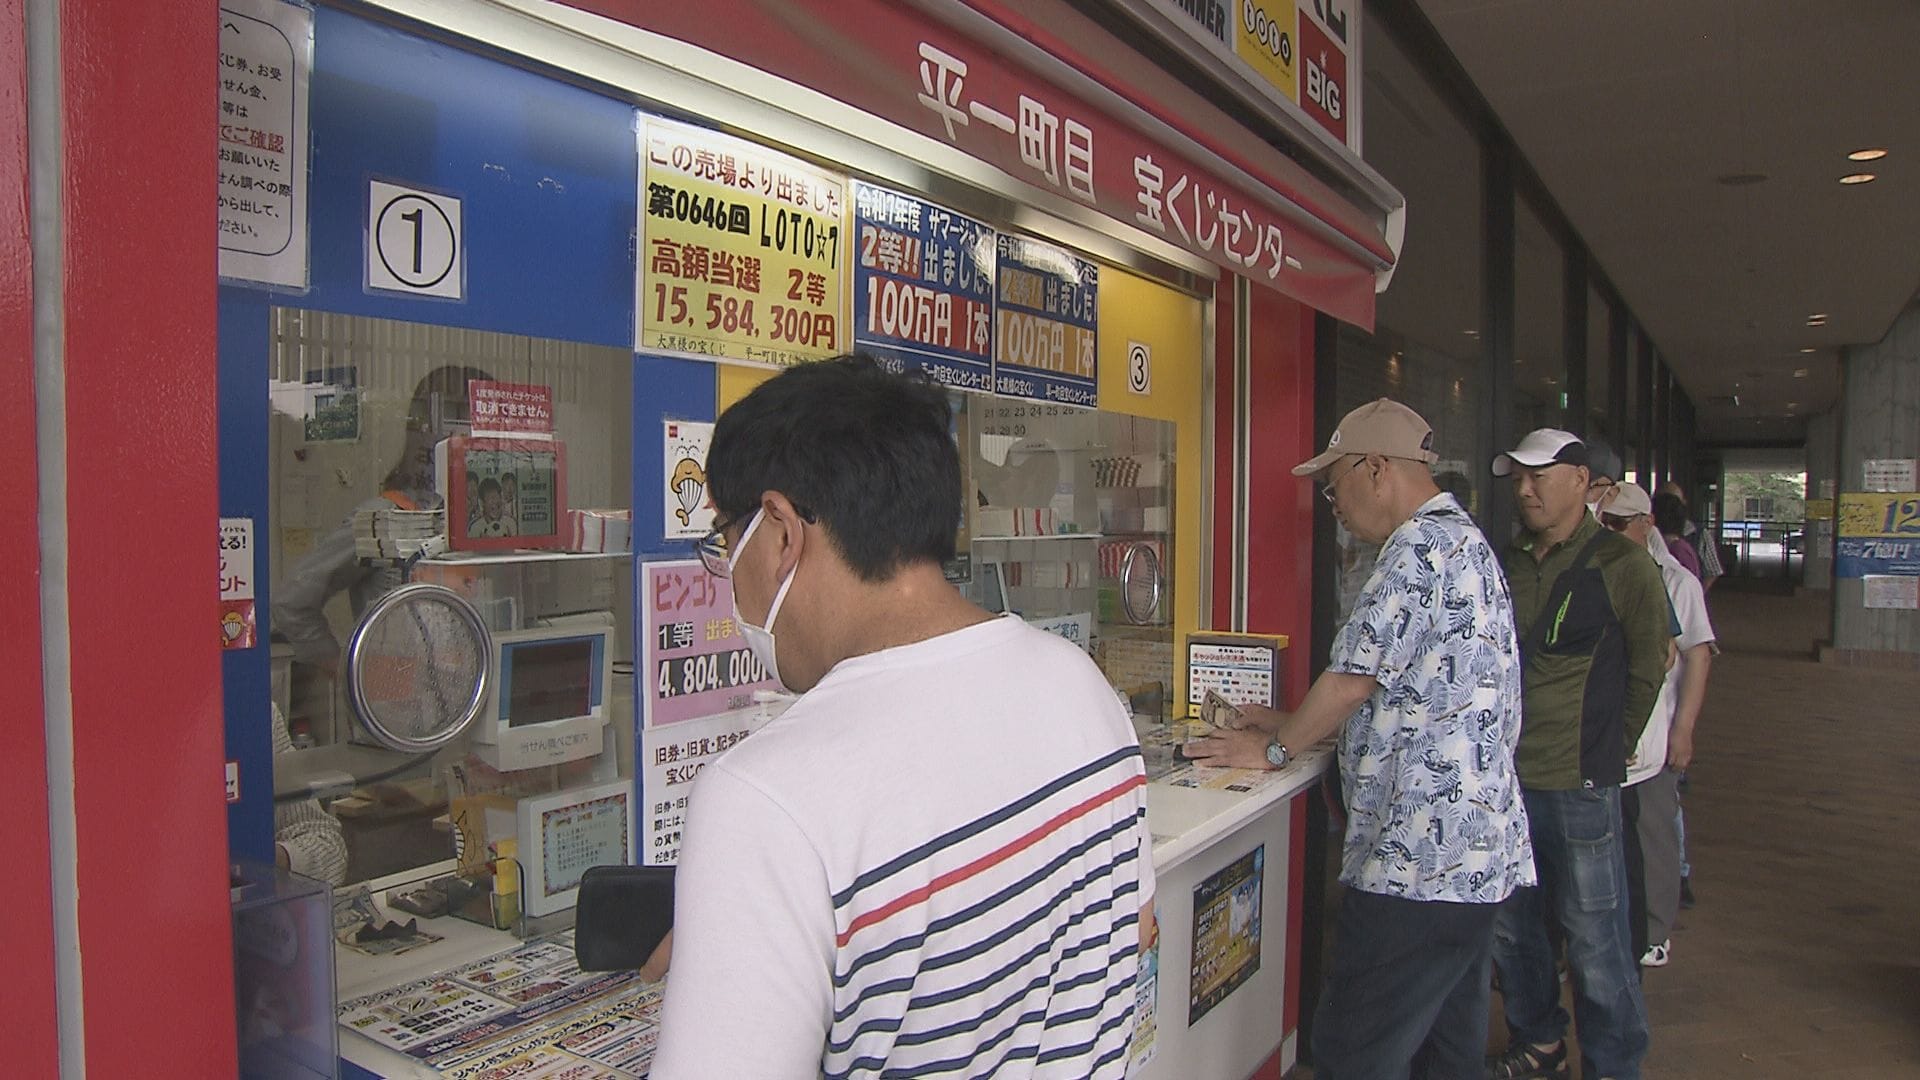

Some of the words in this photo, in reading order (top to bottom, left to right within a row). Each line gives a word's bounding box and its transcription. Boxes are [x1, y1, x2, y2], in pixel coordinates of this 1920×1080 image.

[1243, 0, 1291, 66] toto
[1307, 58, 1341, 120] BIG
[650, 138, 839, 218] この売場より出ました
[918, 42, 1097, 205] 平一町目
[1135, 155, 1303, 280] 宝くじセンター
[647, 182, 750, 236] 第0646回
[857, 187, 922, 235] 令和7年度
[651, 238, 761, 294] 高額当選
[786, 268, 827, 307] 2等
[868, 276, 952, 348] 100万円
[965, 301, 990, 356] 1本
[656, 333, 728, 357] 大黒様の宝くじ
[996, 309, 1065, 373] 100万円
[1075, 328, 1096, 378] 1本
[475, 400, 549, 419] 取消できません。
[1014, 407, 1026, 417] 23
[1030, 407, 1042, 417] 24
[1014, 424, 1026, 436] 30
[1861, 541, 1911, 560] 7億円
[658, 621, 694, 651] 1等
